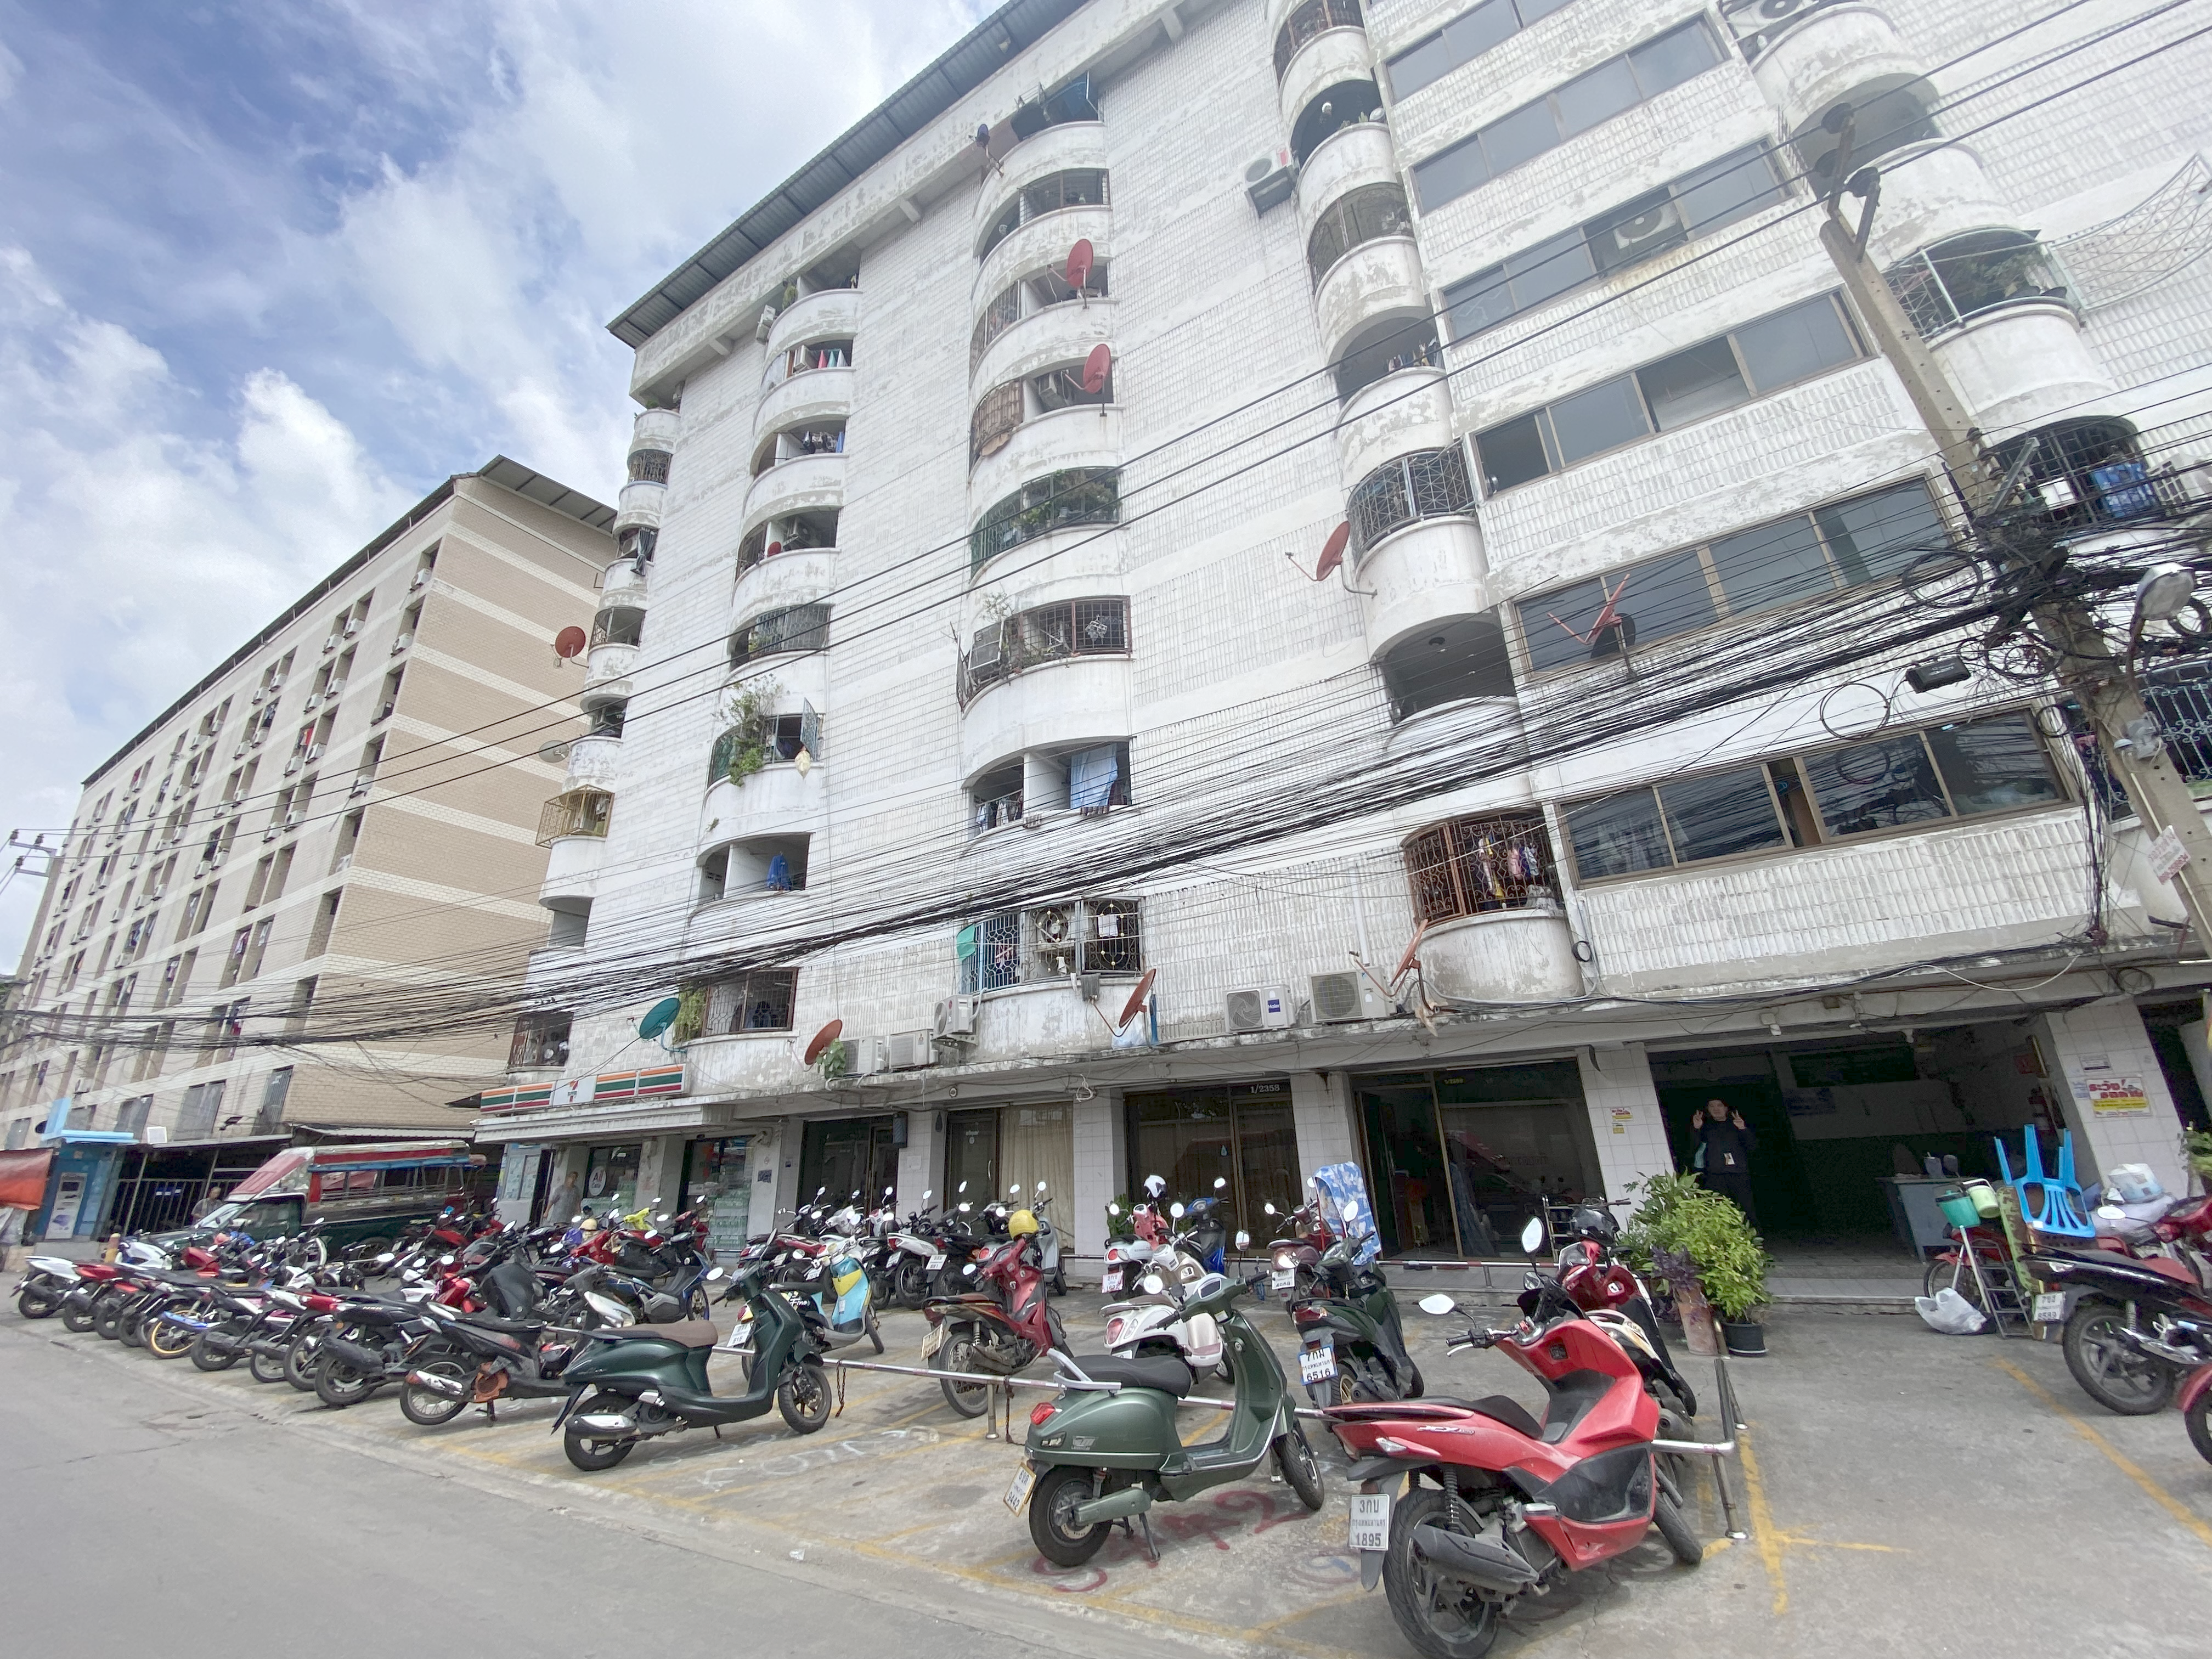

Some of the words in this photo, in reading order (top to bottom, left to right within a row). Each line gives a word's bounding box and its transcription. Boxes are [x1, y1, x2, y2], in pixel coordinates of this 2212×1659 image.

[1250, 1084, 1280, 1094] 1/2358
[592, 1169, 604, 1182] All
[1307, 1368, 1331, 1381] 6516
[1007, 1492, 1020, 1510] 9442
[1356, 1533, 1381, 1547] 1895
